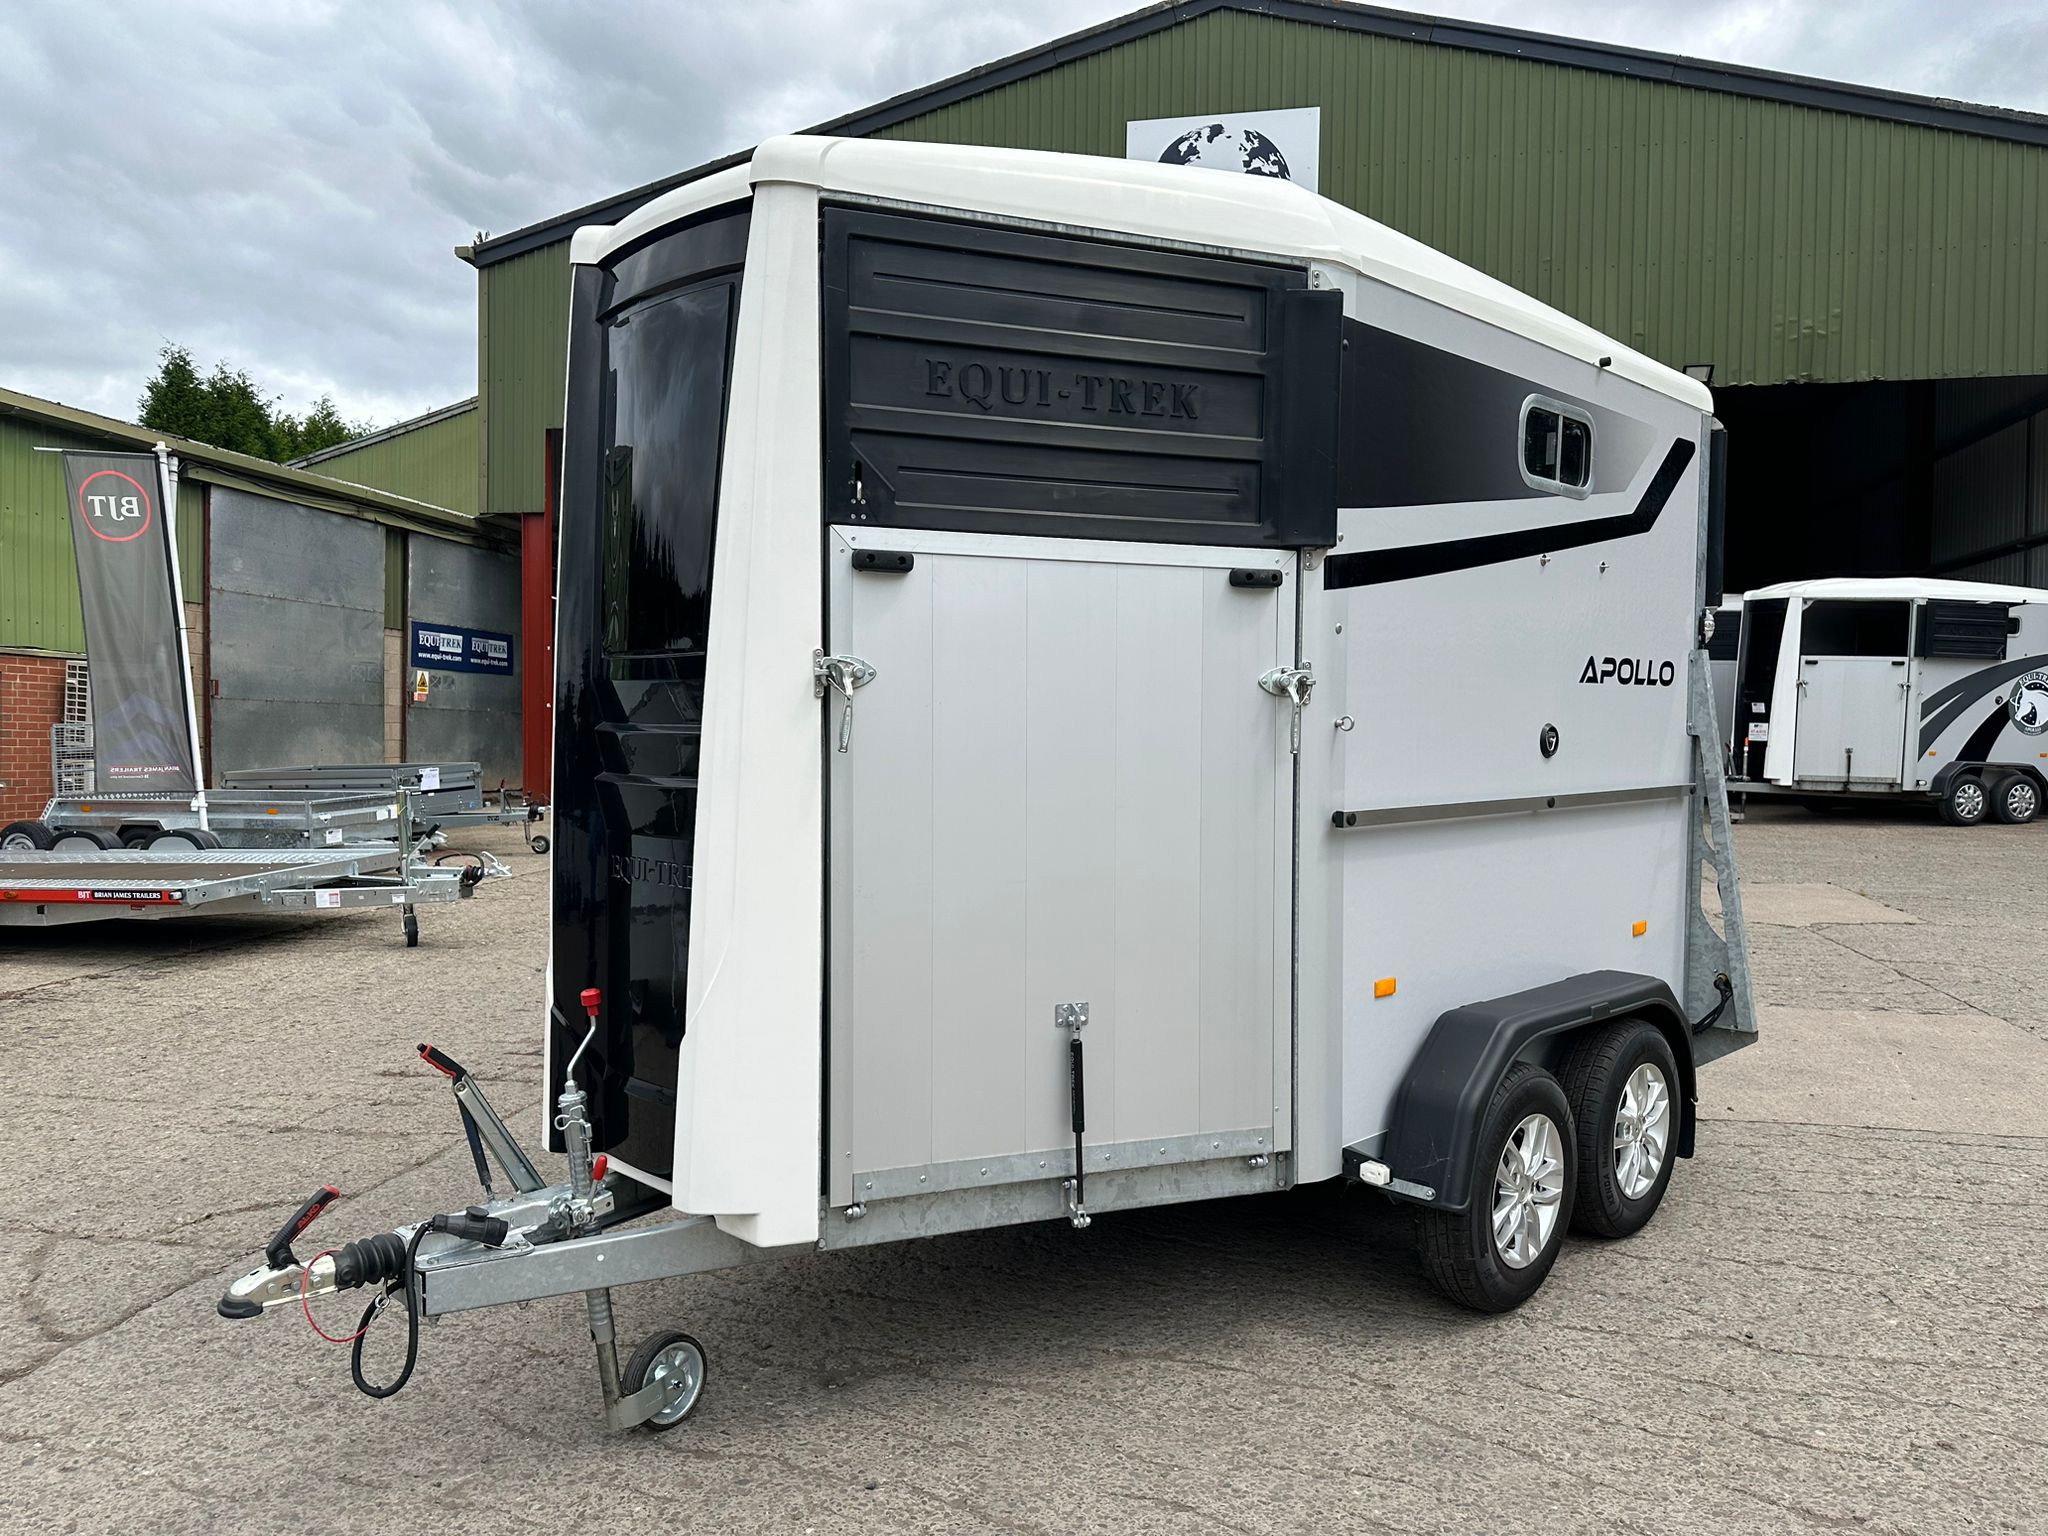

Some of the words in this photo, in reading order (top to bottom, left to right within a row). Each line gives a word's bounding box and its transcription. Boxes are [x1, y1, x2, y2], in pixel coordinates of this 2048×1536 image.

[925, 358, 1199, 419] EQUI-TREK
[1579, 655, 1675, 687] APOLLO
[2018, 672, 2048, 685] EQUI-TR
[77, 890, 91, 899] BJT
[113, 891, 132, 899] JAMES
